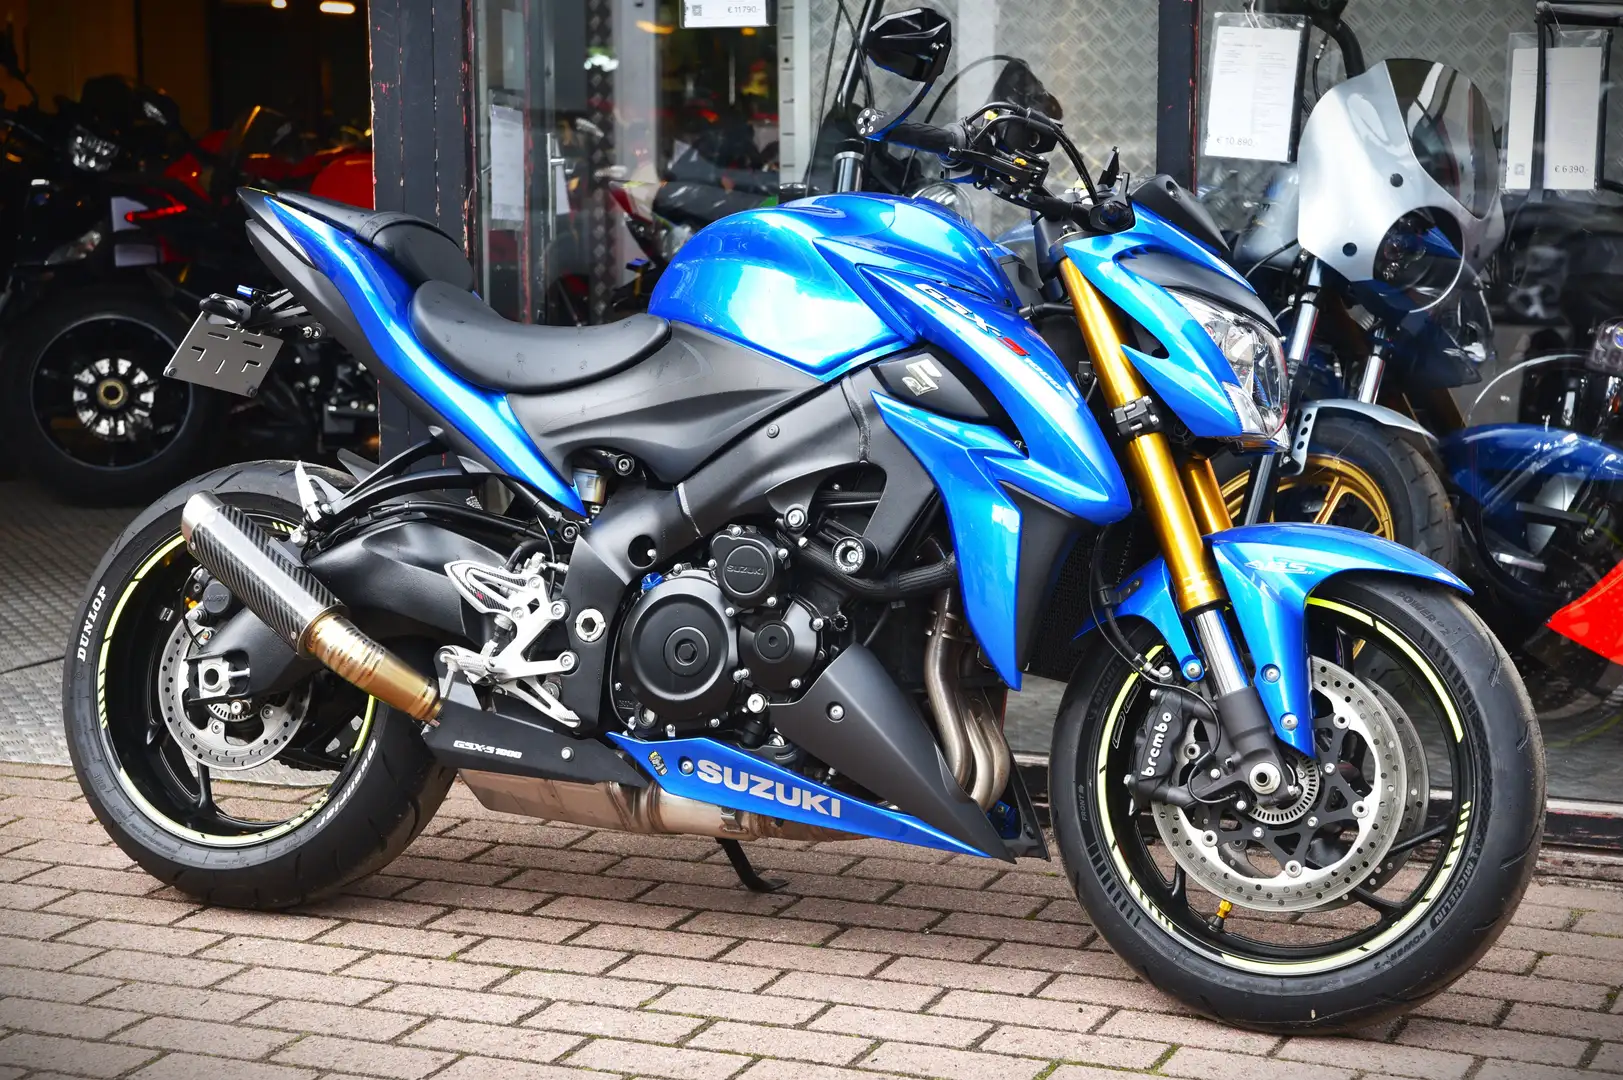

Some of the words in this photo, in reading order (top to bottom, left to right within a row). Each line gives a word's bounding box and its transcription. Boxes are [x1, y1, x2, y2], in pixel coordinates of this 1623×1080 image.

[1024, 358, 1063, 391] 1000
[726, 564, 765, 576] SUZUKI
[77, 585, 106, 662] DUNLOP
[453, 740, 495, 754] GSX-S
[495, 748, 523, 759] 1000
[1141, 712, 1172, 777] brembo
[696, 759, 842, 818] SUZUKI
[1079, 794, 1087, 821] FRONT
[1434, 862, 1475, 924] MICHELIN
